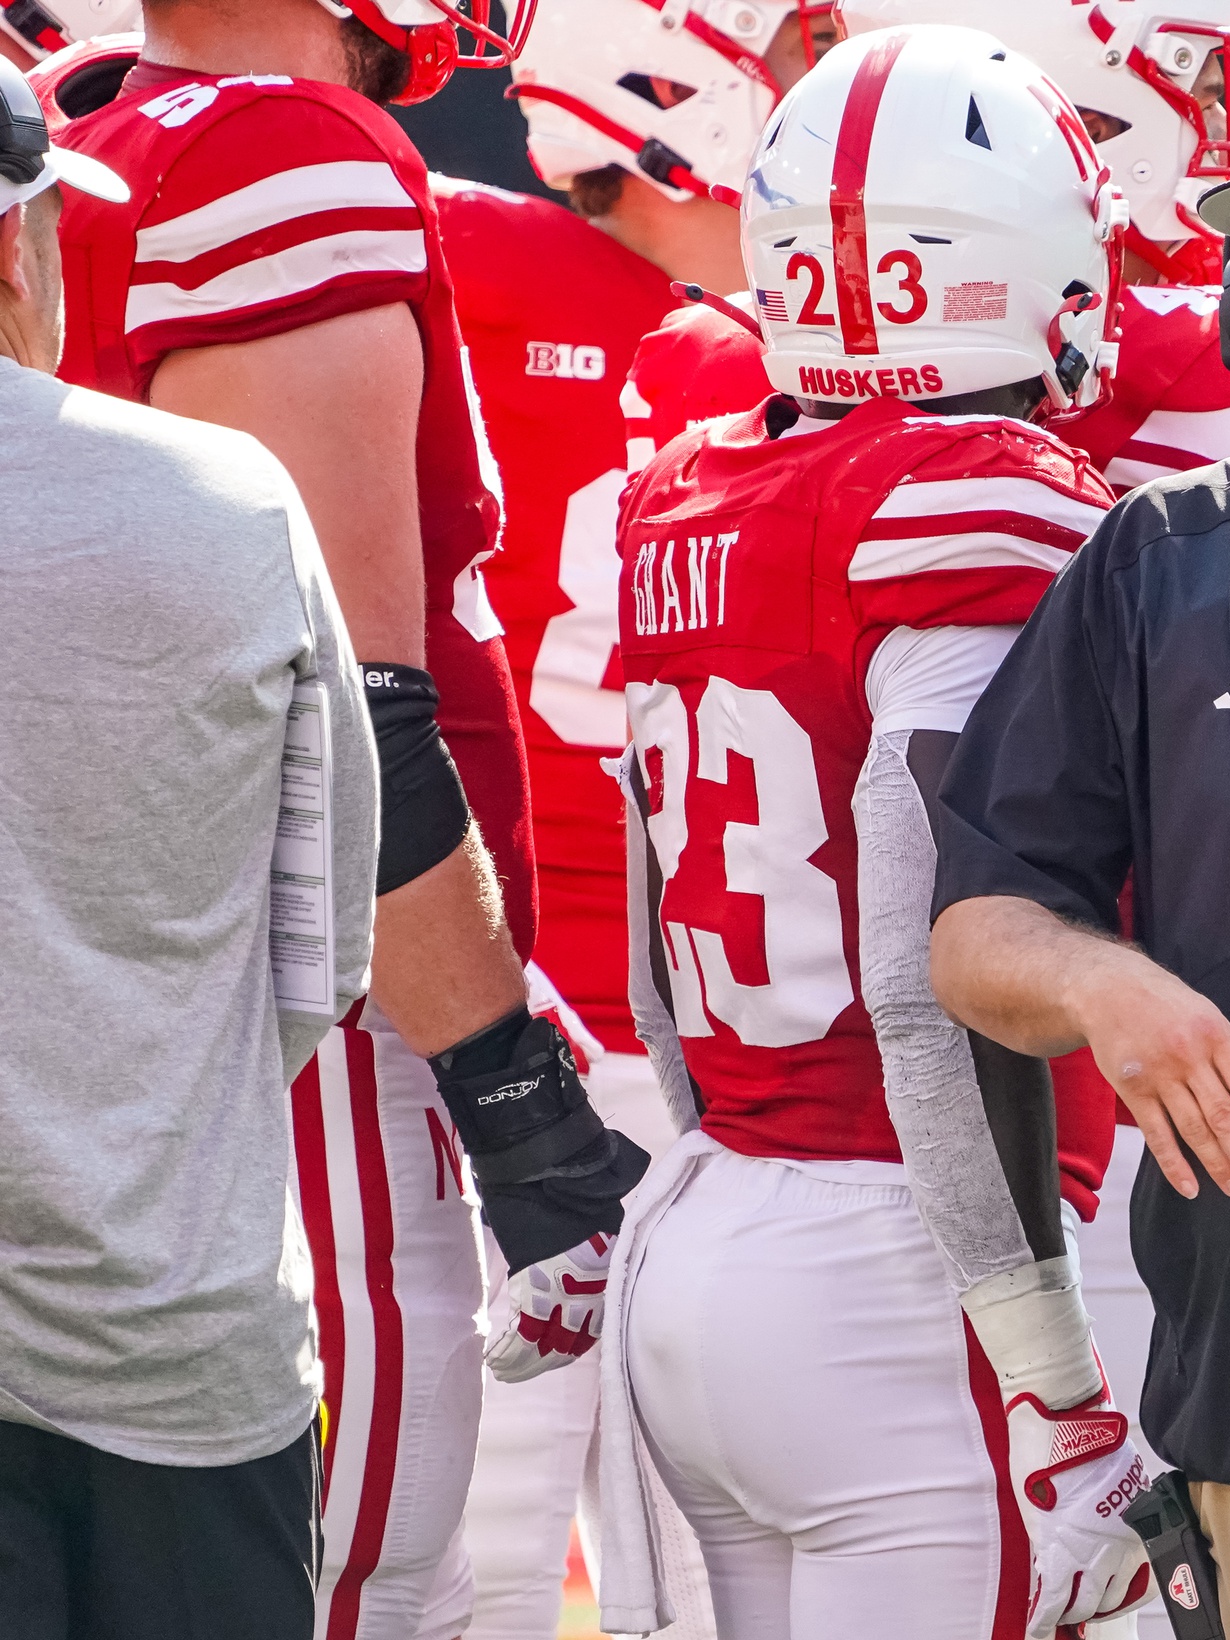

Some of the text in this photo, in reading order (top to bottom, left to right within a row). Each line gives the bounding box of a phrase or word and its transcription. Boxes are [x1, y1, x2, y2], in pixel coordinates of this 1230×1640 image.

[798, 364, 944, 398] HUSKERS
[634, 530, 740, 636] GRANT
[625, 675, 855, 1047] 23
[478, 1076, 540, 1105] DONJOY
[1061, 1428, 1115, 1453] FREAK
[1096, 1454, 1144, 1518] adidas
